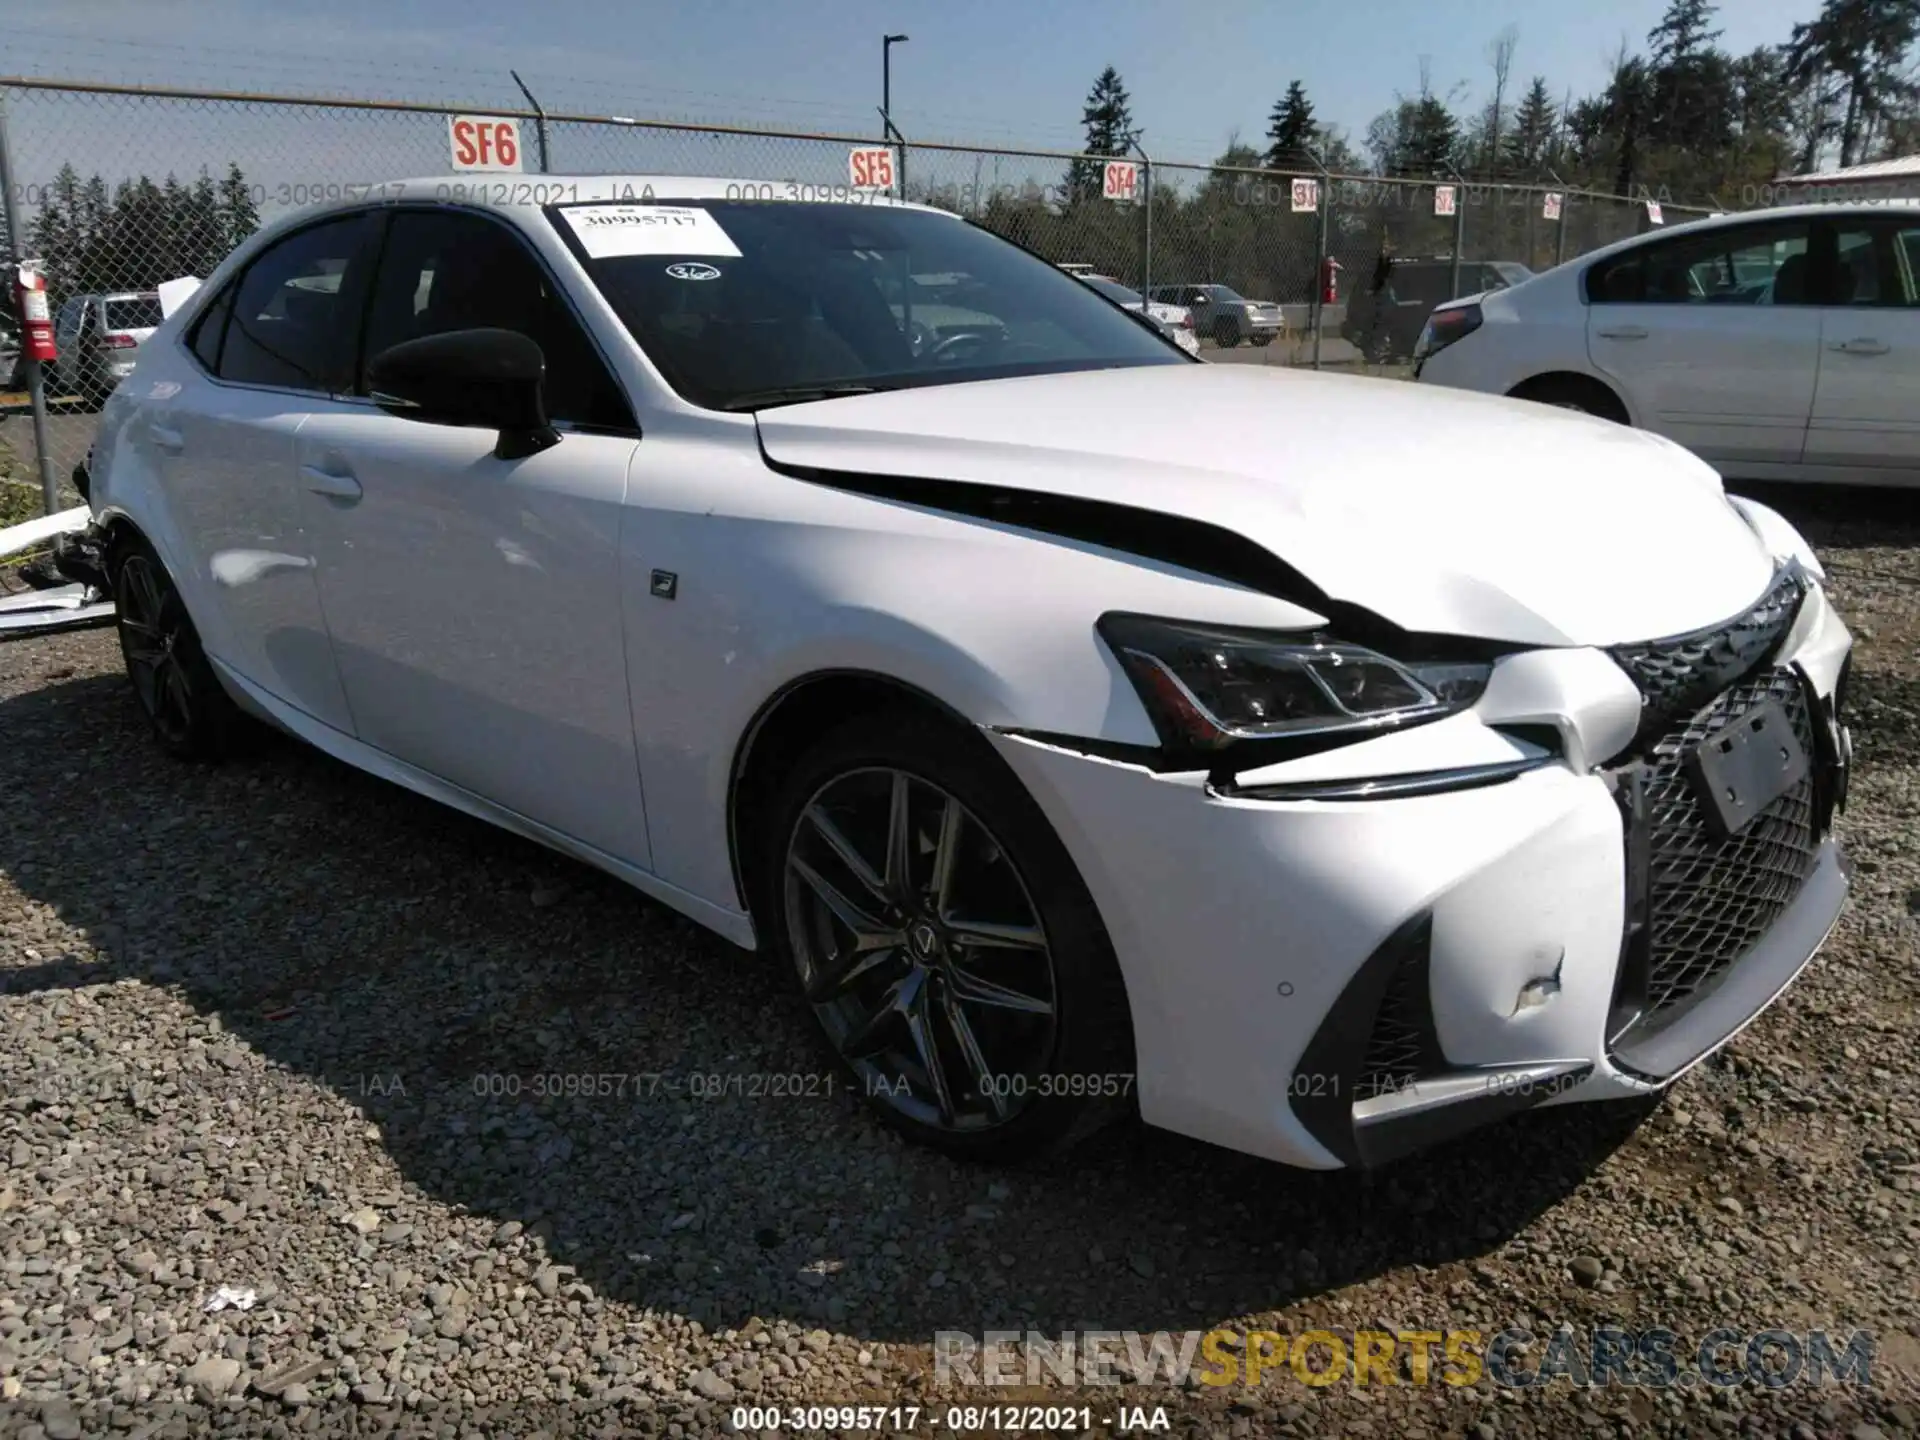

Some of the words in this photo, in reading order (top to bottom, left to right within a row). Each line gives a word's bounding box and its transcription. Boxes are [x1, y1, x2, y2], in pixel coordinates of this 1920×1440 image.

[454, 120, 517, 167] SF6
[852, 151, 892, 186] SF5
[1106, 164, 1134, 195] SF4
[583, 215, 696, 227] 30995717
